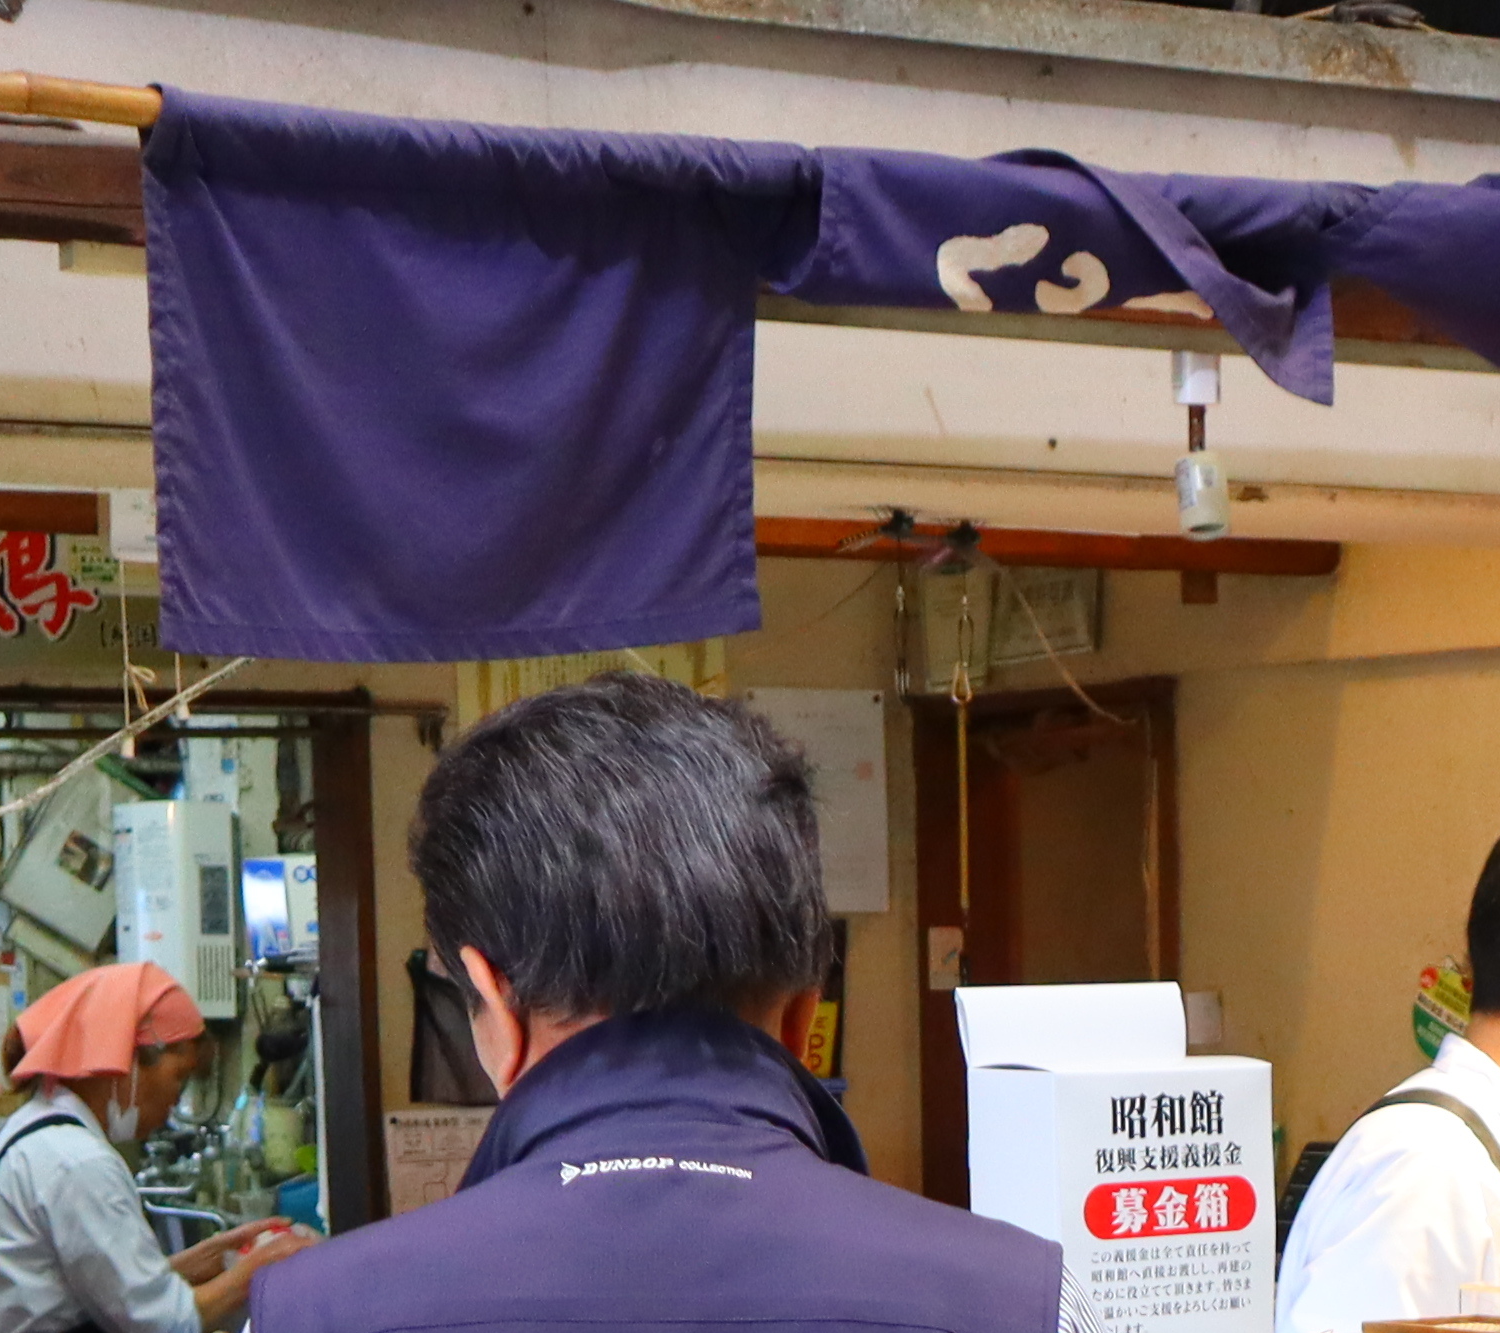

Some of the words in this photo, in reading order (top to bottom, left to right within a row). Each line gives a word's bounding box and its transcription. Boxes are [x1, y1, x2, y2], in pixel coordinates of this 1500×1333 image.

[1110, 1089, 1225, 1140] 昭和館
[581, 1157, 674, 1177] DUNLOP
[679, 1161, 752, 1180] COLLECTION
[1095, 1141, 1243, 1175] 復興支援義援金
[1111, 1182, 1229, 1236] 募金箱
[1091, 1241, 1252, 1264] この義援金は全て責任を持って
[1100, 1297, 1252, 1321] 温かいご支援をよろしくお願い
